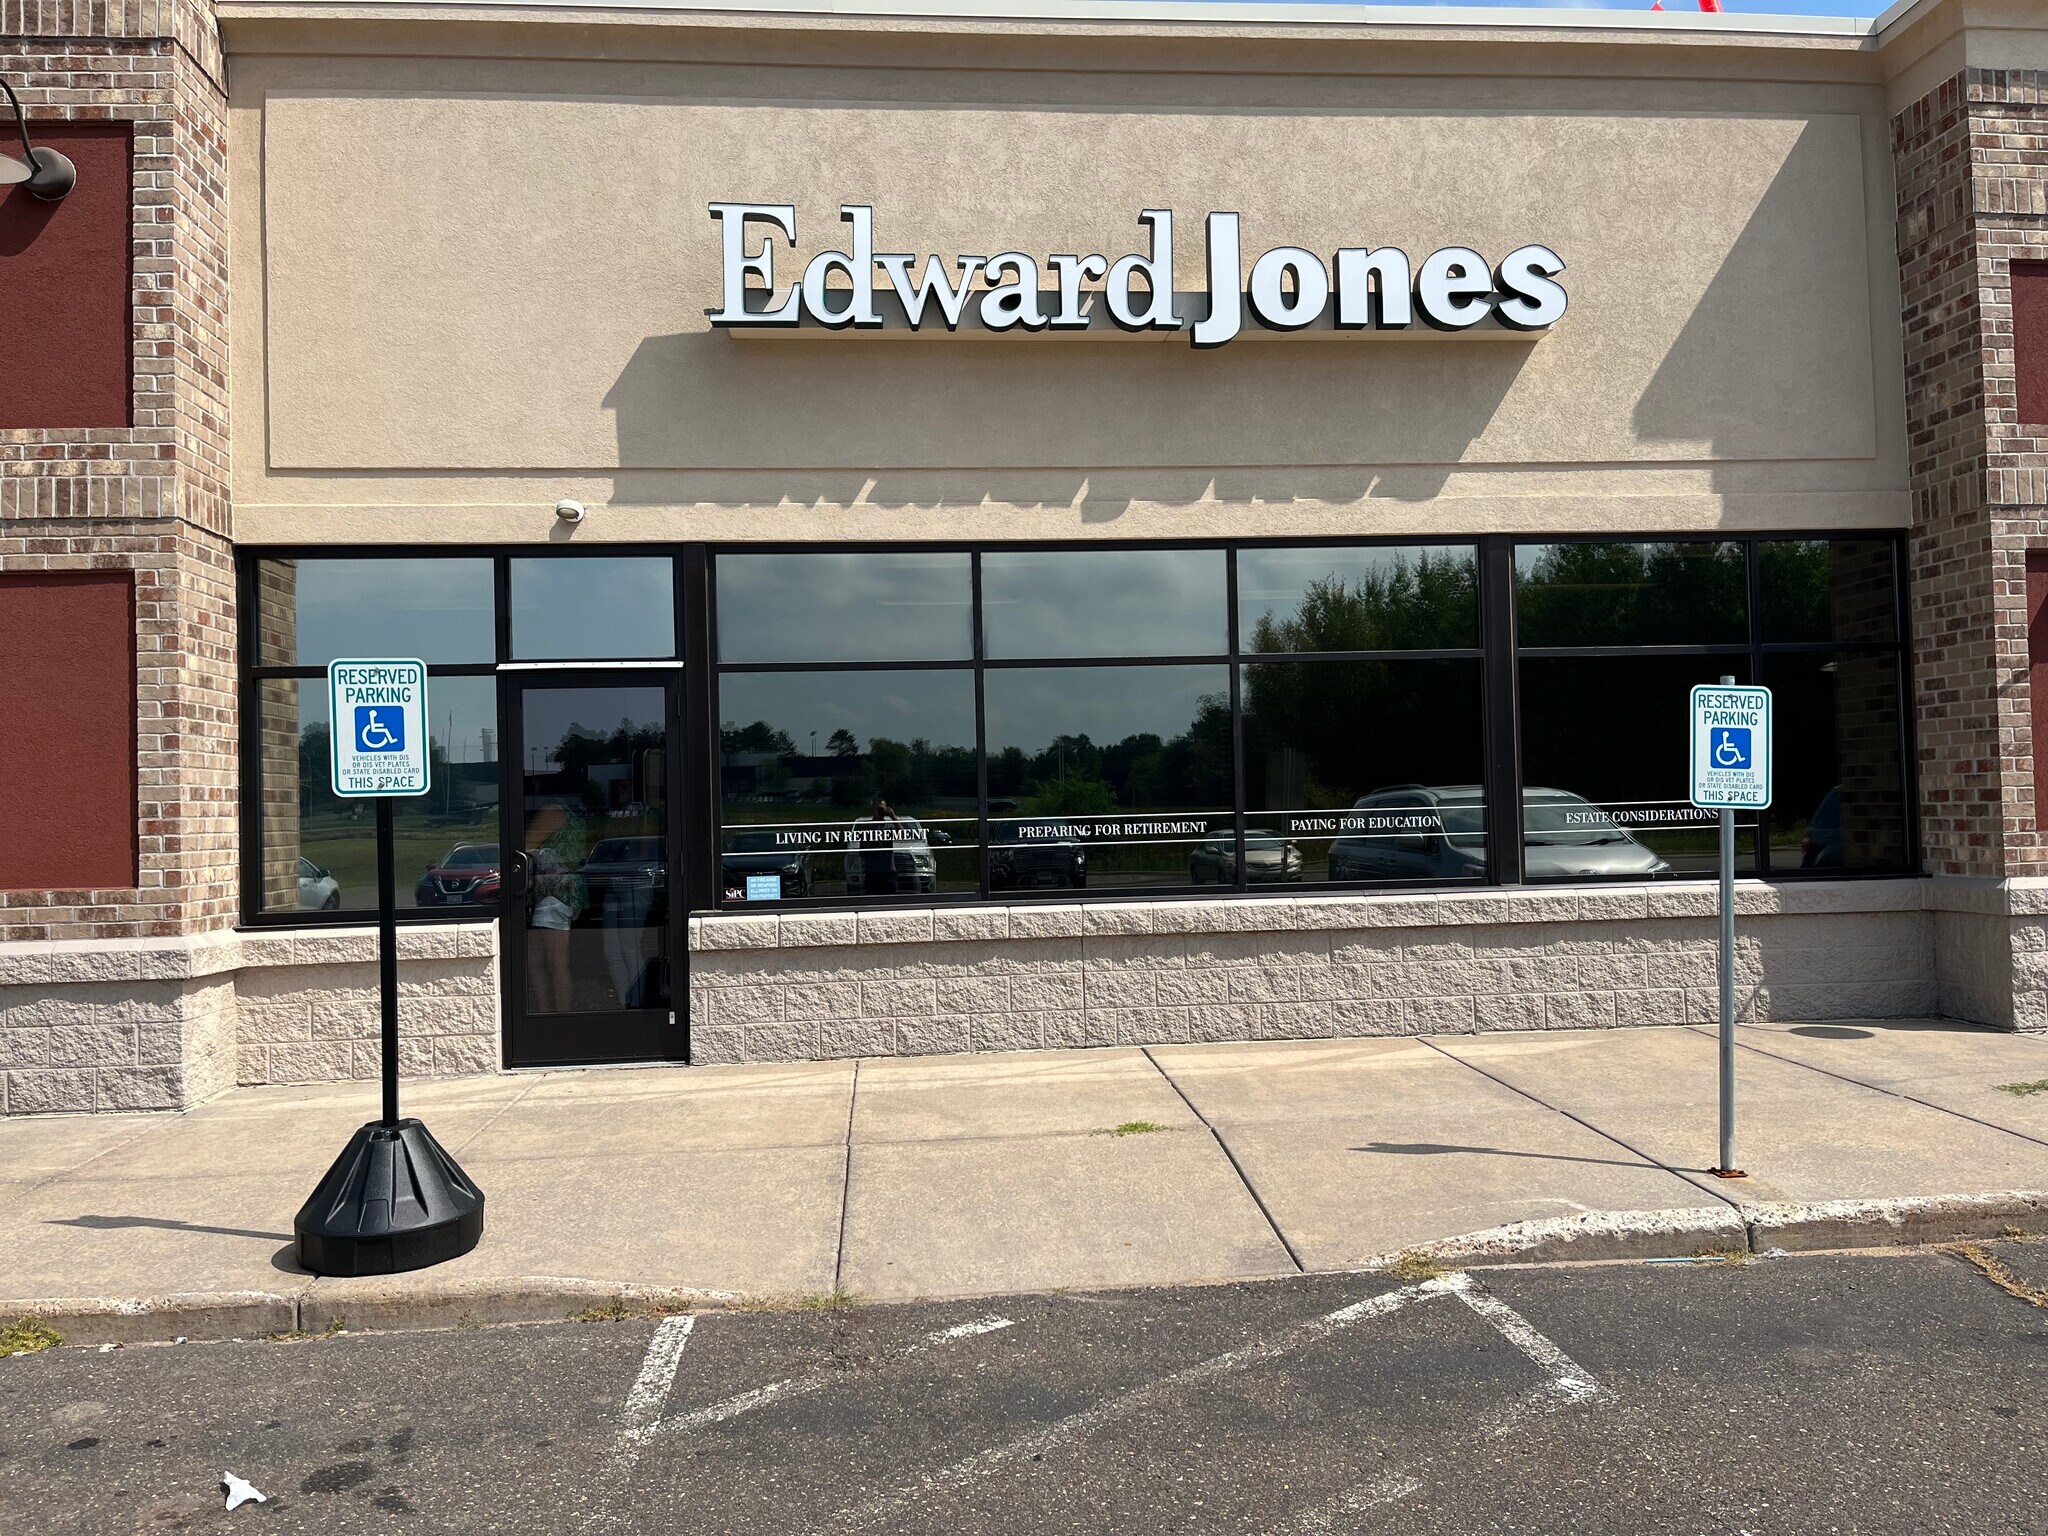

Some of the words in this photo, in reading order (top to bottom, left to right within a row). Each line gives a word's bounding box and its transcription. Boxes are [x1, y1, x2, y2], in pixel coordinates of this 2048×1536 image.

[708, 202, 1184, 331] Edward
[1190, 211, 1568, 348] Jones
[338, 669, 417, 685] RESERVED
[345, 687, 411, 703] PARKING
[1698, 694, 1764, 710] RESERVED
[1703, 711, 1758, 726] PARKING
[348, 777, 373, 788] THIS
[378, 776, 414, 788] SPACE
[1703, 790, 1724, 800] THIS
[1727, 791, 1758, 802] SPACE
[1290, 818, 1336, 831] PAYING
[1339, 817, 1366, 830] FOR
[1368, 815, 1441, 829] EDUCATION
[1566, 811, 1610, 824] ESTATE
[1612, 808, 1719, 822] CONSIDERATIONS
[775, 832, 822, 845] LIVING
[825, 831, 841, 843] IN
[843, 828, 930, 842] RETIREMENT
[1018, 824, 1091, 838] PREPARING
[1094, 824, 1121, 836] FOR
[1124, 821, 1207, 835] RETIREMENT
